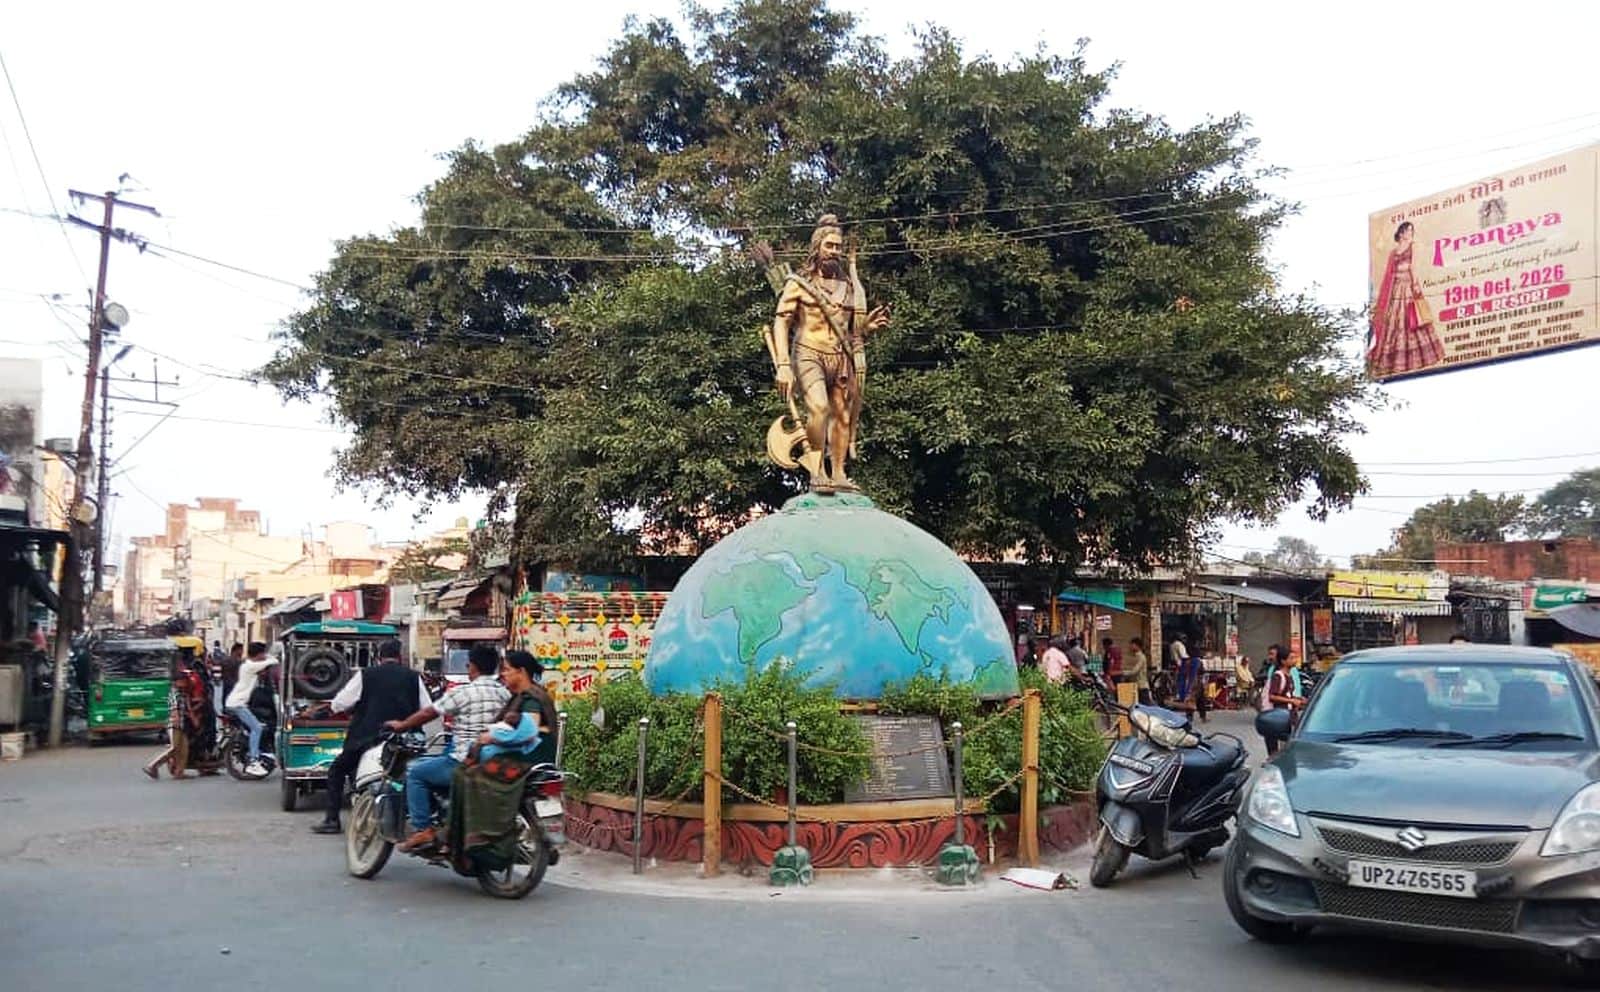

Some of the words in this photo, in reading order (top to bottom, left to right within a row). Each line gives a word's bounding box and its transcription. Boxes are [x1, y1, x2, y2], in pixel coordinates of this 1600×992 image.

[1470, 177, 1504, 200] सोने
[1444, 284, 1479, 305] 13th
[1520, 264, 1564, 289] 2026
[1491, 288, 1549, 312] RESORT
[1362, 865, 1466, 892] UP24Z6565
